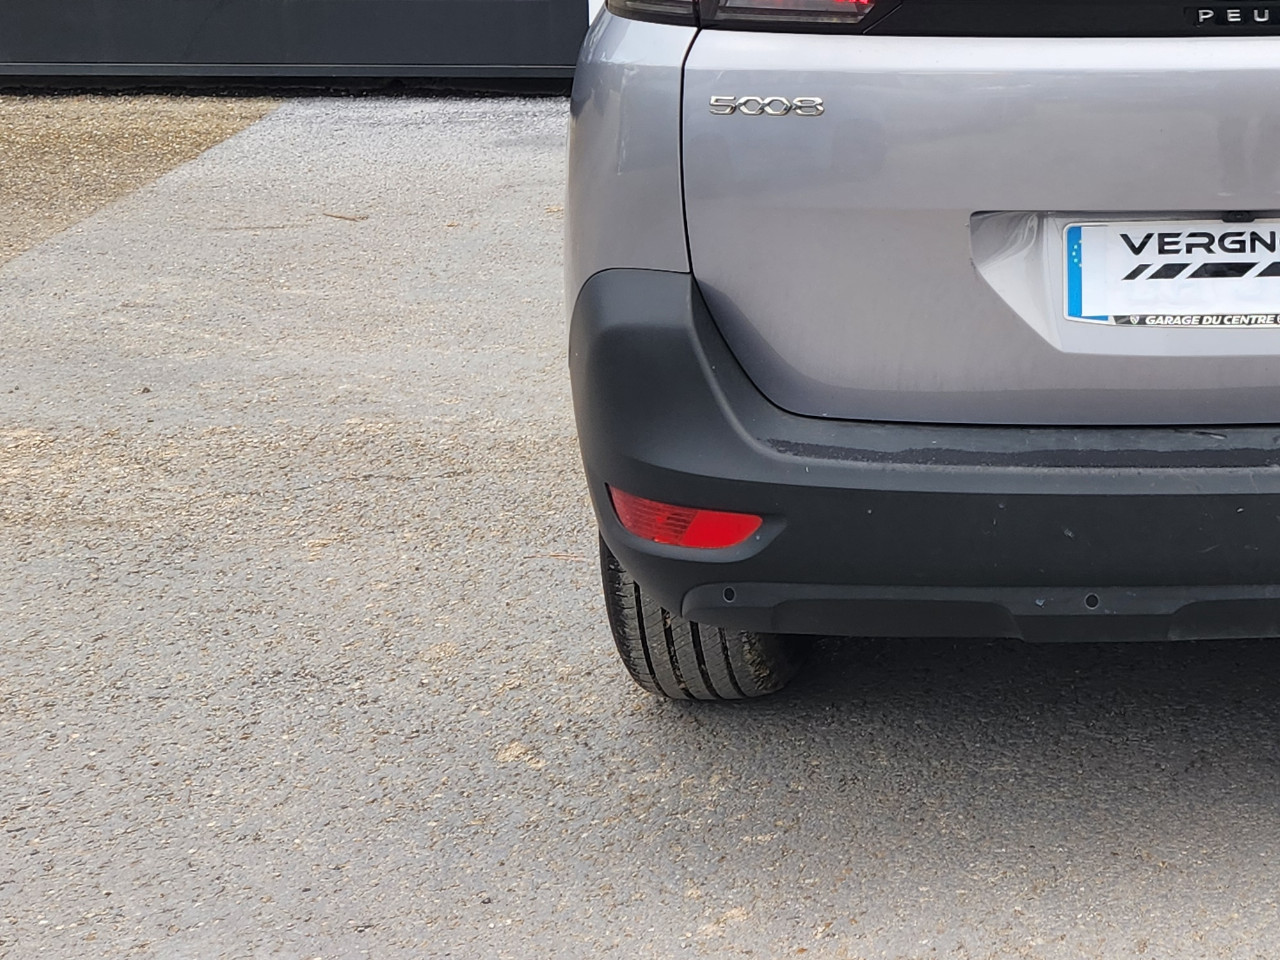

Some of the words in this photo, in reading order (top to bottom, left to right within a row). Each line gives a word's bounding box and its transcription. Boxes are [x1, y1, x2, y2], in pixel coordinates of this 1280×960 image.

[709, 95, 825, 116] 5008
[1145, 315, 1200, 325] GARAGE
[1202, 315, 1222, 325] DU
[1223, 314, 1275, 325] CENTRE
